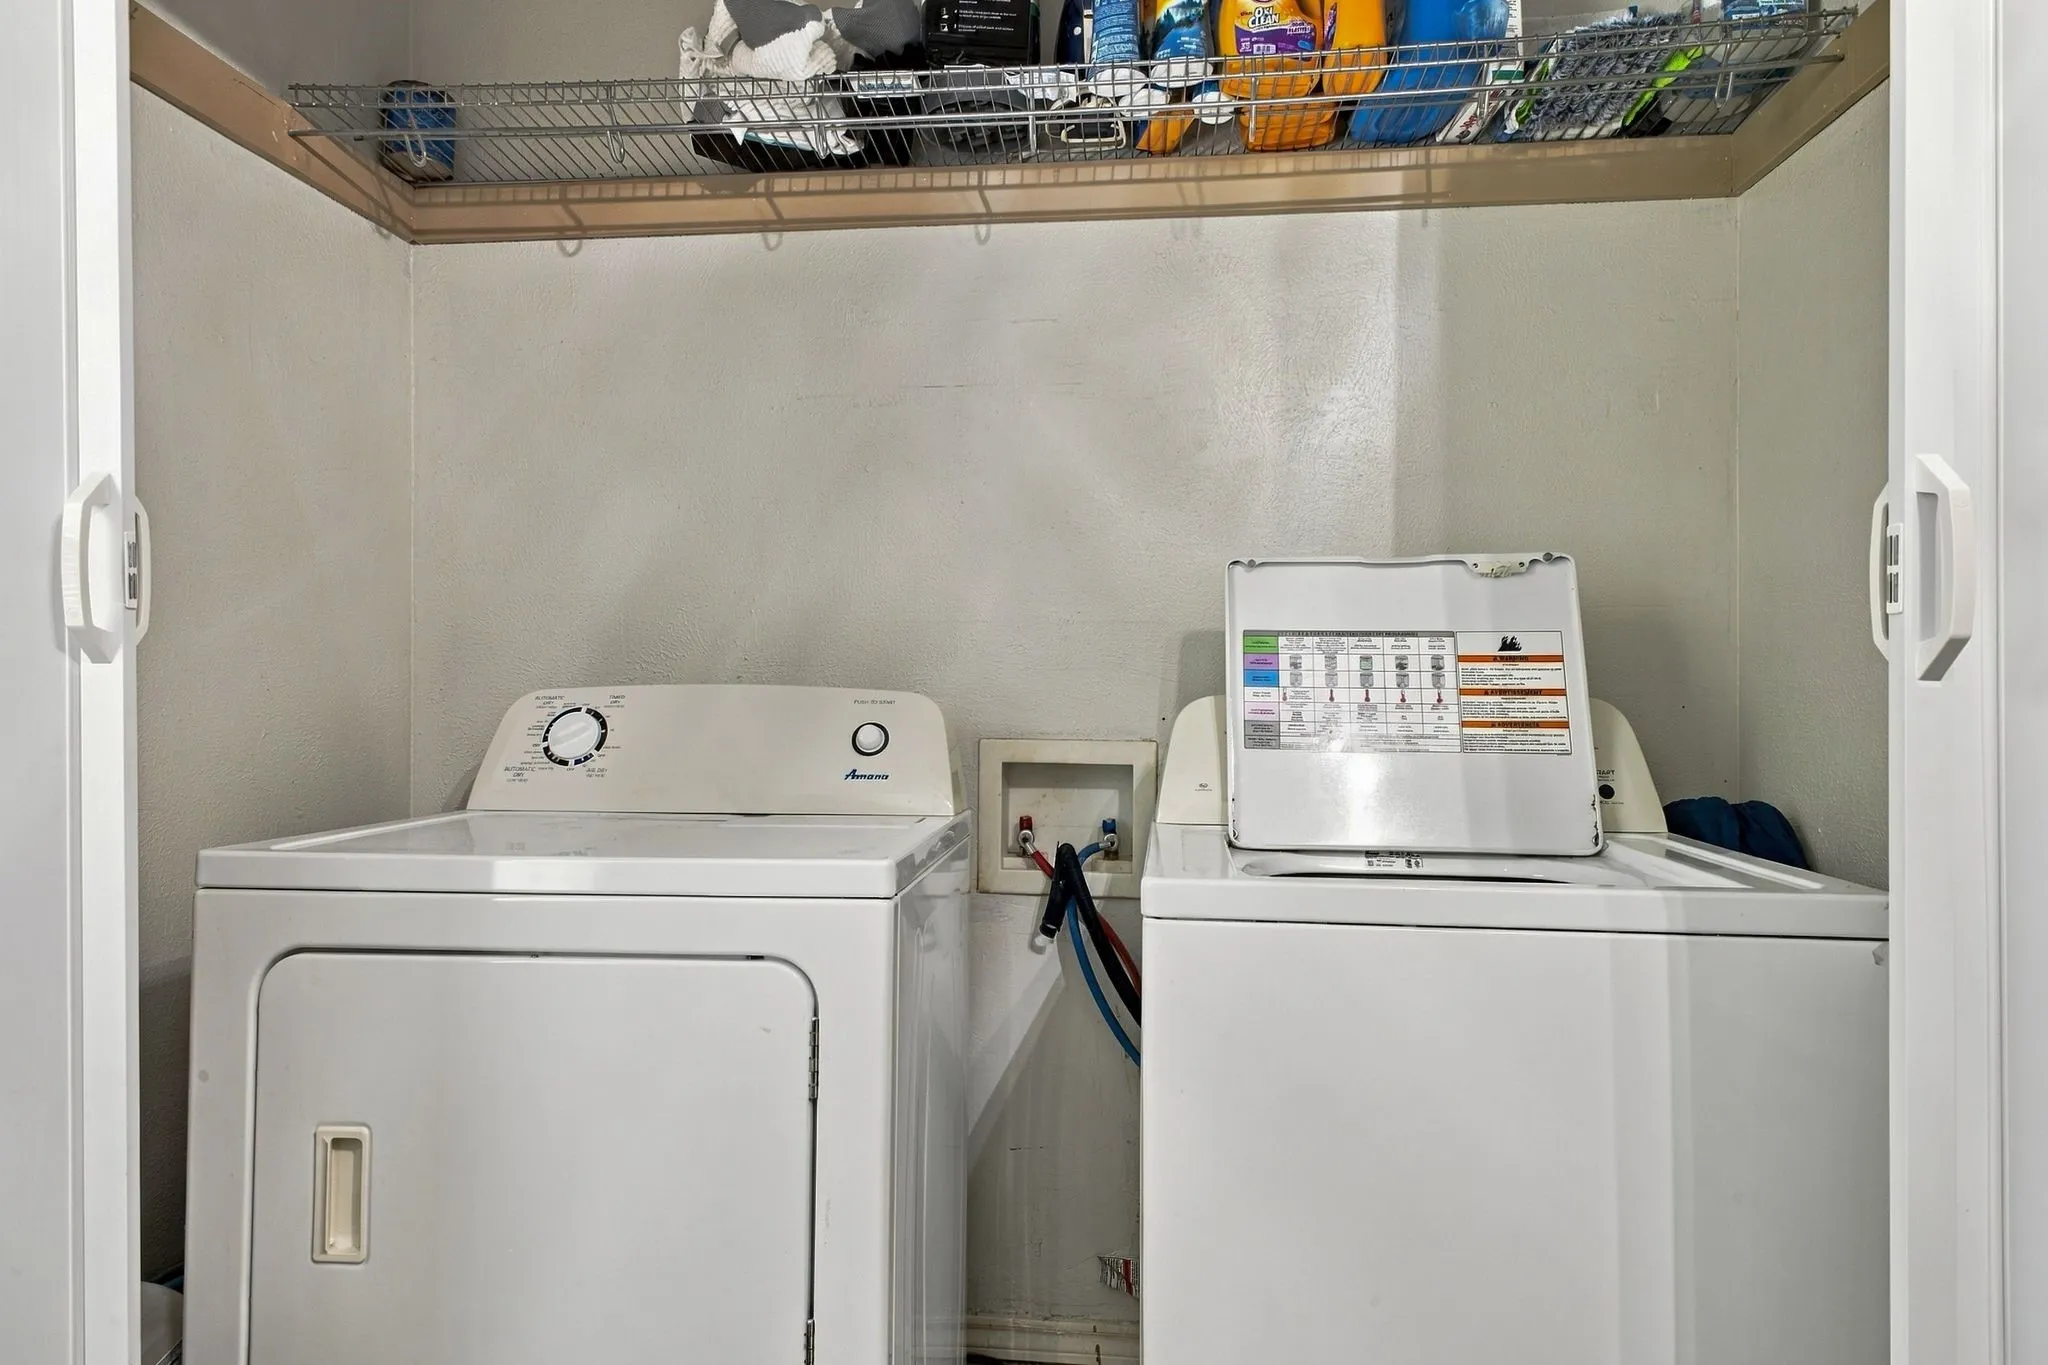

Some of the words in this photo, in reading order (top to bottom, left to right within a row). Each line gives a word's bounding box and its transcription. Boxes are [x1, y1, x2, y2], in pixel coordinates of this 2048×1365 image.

[1254, 6, 1273, 18] OXI
[1248, 13, 1280, 28] CLEAN
[844, 768, 889, 780] Amana
